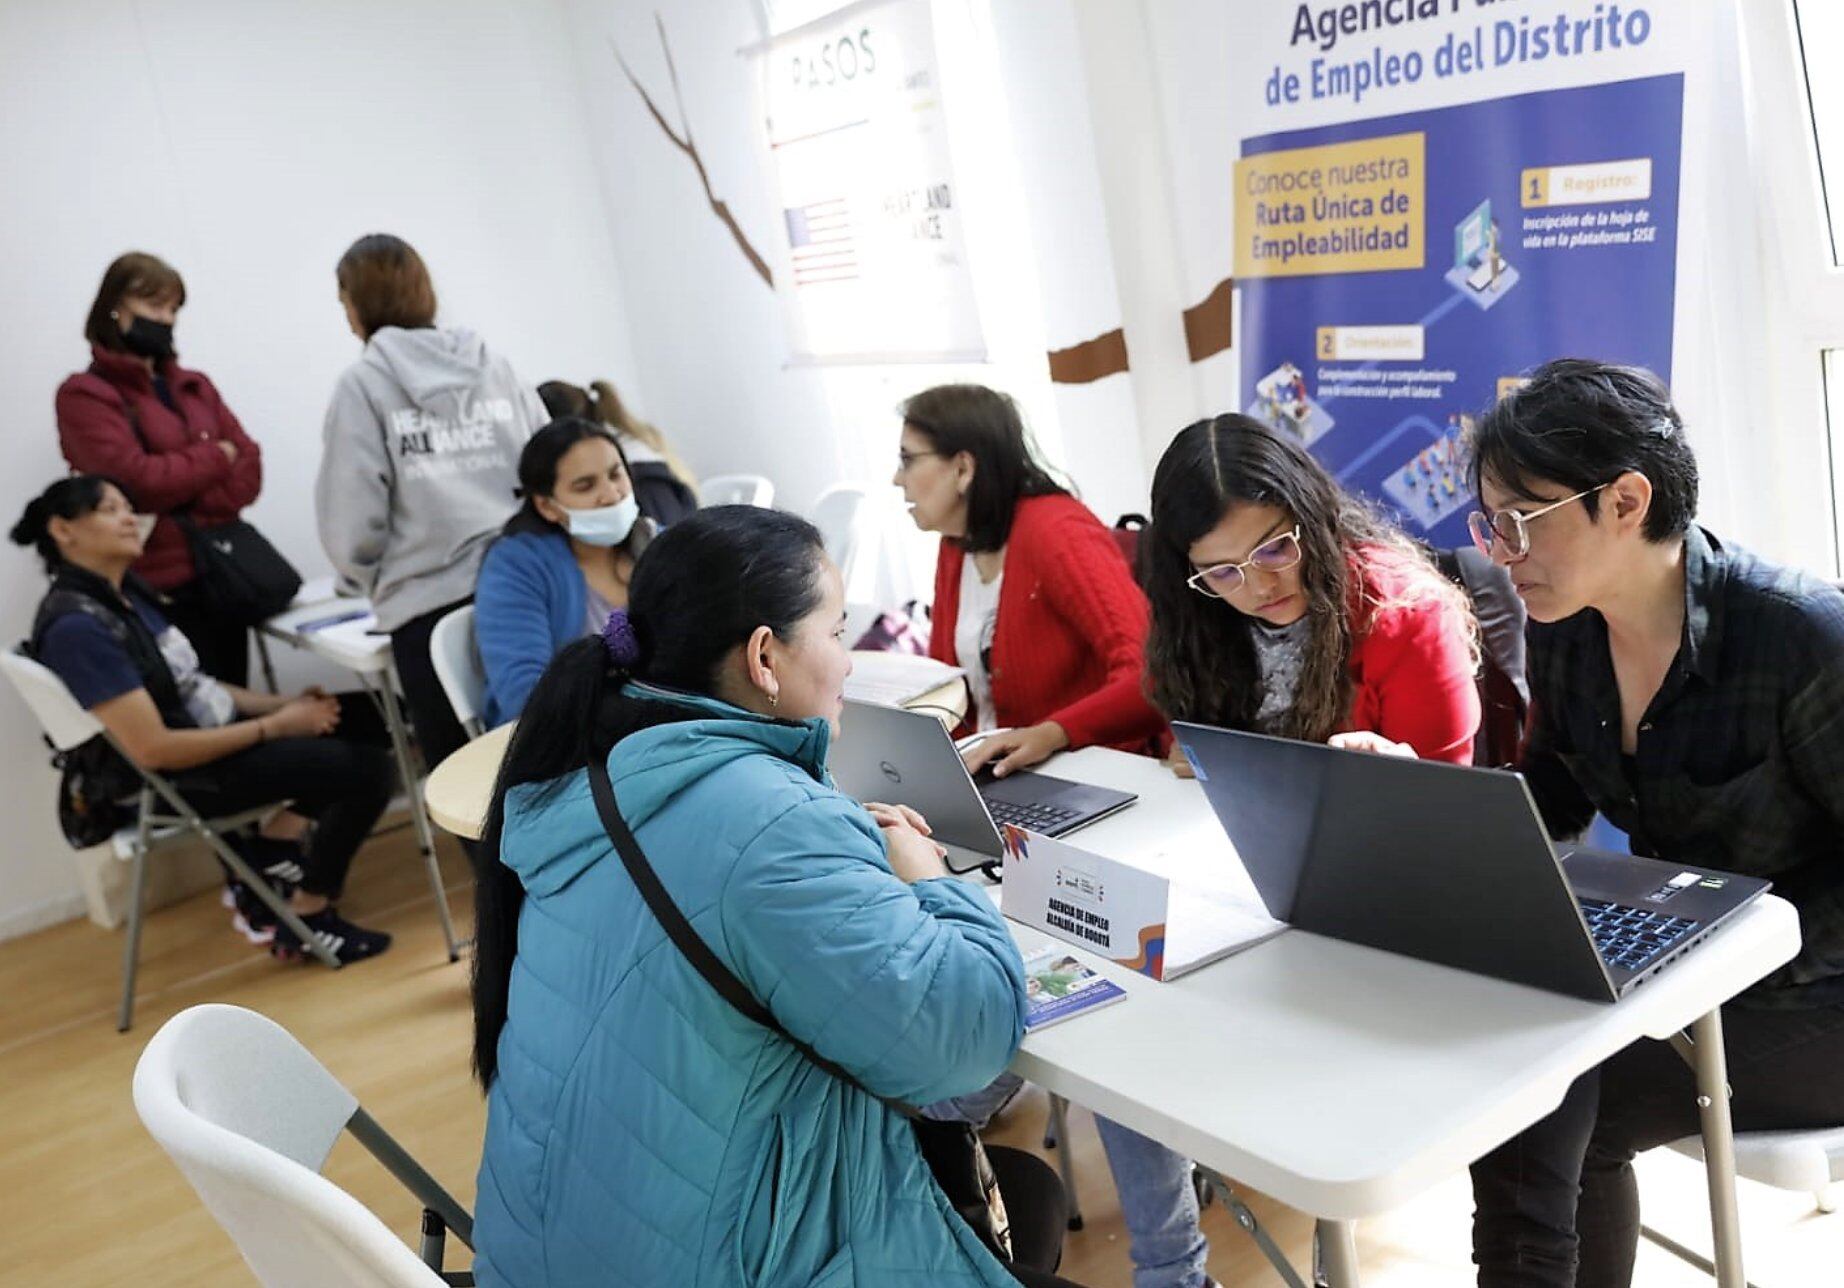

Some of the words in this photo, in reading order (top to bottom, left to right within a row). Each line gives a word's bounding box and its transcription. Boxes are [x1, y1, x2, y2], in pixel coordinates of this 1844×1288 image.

[1290, 0, 1438, 51] Agencia
[1266, 66, 1300, 106] de
[1311, 46, 1423, 103] Empleo
[1434, 27, 1484, 78] del
[1494, 4, 1651, 67] Distrito
[1246, 168, 1322, 195] Conoce
[1328, 157, 1409, 187] nuestra
[1529, 177, 1541, 200] 1
[1256, 201, 1306, 226] Ruta
[1312, 189, 1374, 220] Única
[1380, 187, 1409, 215] de
[1252, 223, 1409, 263] Empleabilidad
[1323, 334, 1334, 354] 2
[1048, 896, 1075, 918] AGENCIA
[1075, 907, 1084, 922] DE
[1084, 909, 1109, 932] EMPLEO
[1075, 923, 1084, 938] DE
